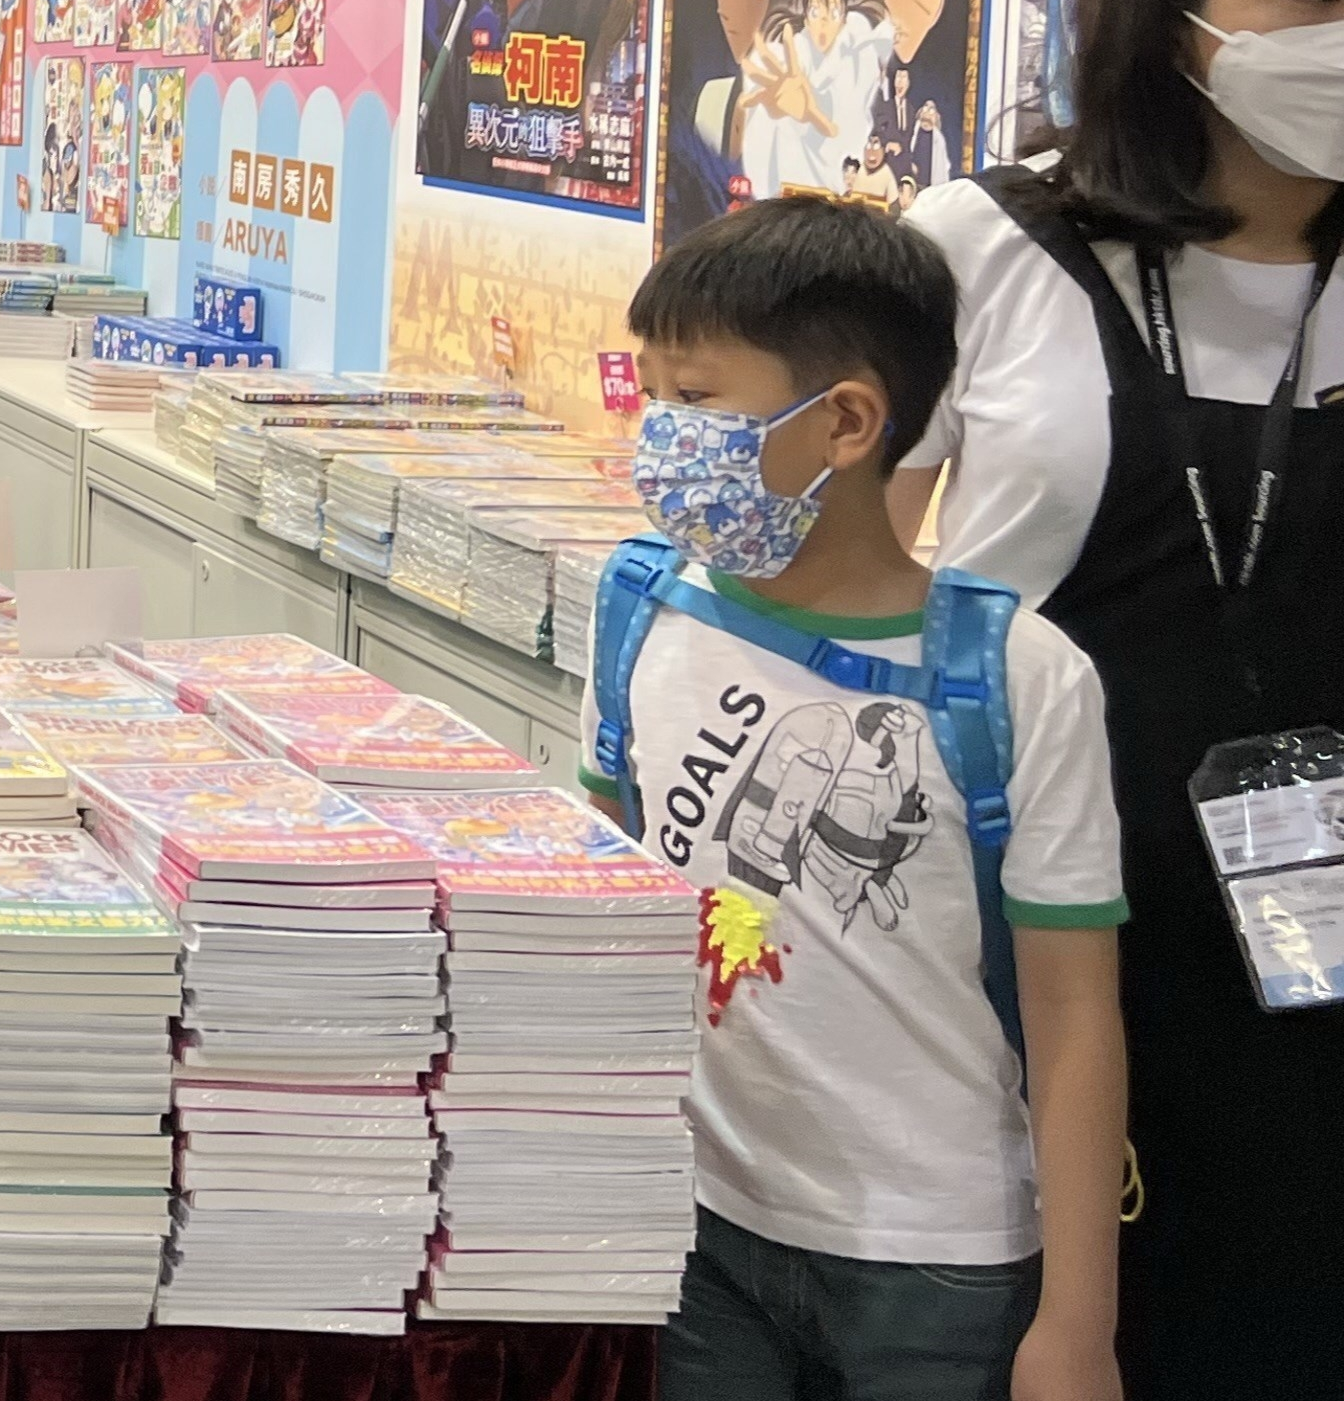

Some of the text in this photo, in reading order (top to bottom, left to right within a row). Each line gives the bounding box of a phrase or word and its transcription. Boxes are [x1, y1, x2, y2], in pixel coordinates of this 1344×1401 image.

[504, 31, 585, 109] 柯南
[466, 104, 584, 163] 異次元的狙擊手
[231, 158, 330, 213] 南房秀久
[223, 217, 288, 265] ARUYA
[659, 684, 766, 867] GOALS
